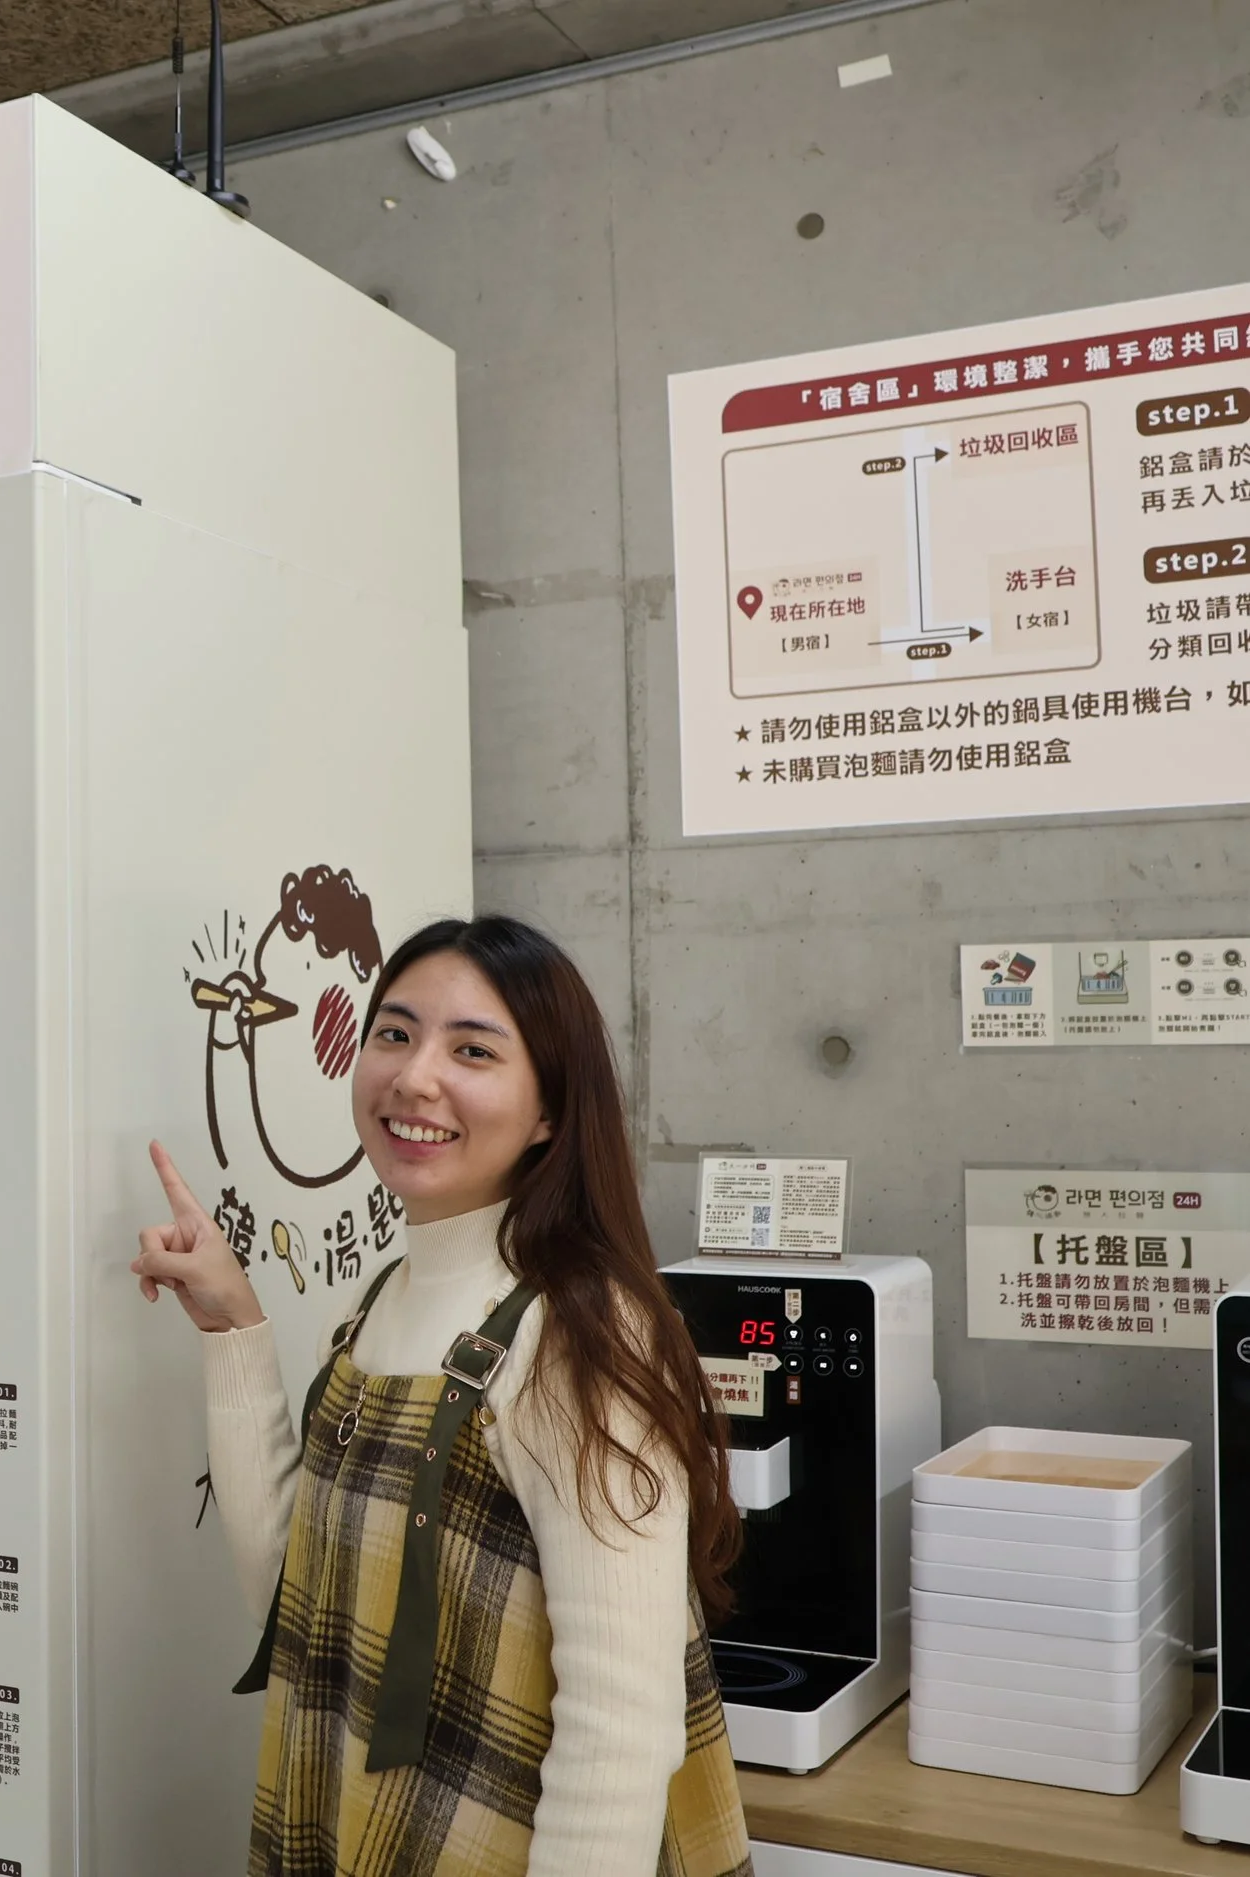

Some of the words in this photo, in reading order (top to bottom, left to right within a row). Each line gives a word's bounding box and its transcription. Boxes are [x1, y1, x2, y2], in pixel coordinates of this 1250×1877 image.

[799, 322, 1250, 411] 「宿舍區」環境整潔，攜手您共同
[1147, 394, 1239, 428] step.1
[959, 423, 1080, 459] 垃圾回收區
[864, 458, 904, 473] step.2
[1155, 544, 1247, 574] step.2
[1005, 566, 1076, 592] 洗手台
[770, 596, 866, 623] 現在所在地
[910, 644, 948, 658] step.1
[1066, 1189, 1101, 1208] 라면
[1109, 1190, 1165, 1210] 편의점
[1176, 1195, 1199, 1207] 24H
[1033, 1233, 1192, 1269] 【托盤區】
[738, 1286, 781, 1294] HAUSCOOK
[1000, 1293, 1218, 1315] 2.托盤可帶回房間，但需
[740, 1320, 776, 1345] 85
[0, 1689, 17, 1701] 03.
[2, 1862, 19, 1875] 04.
